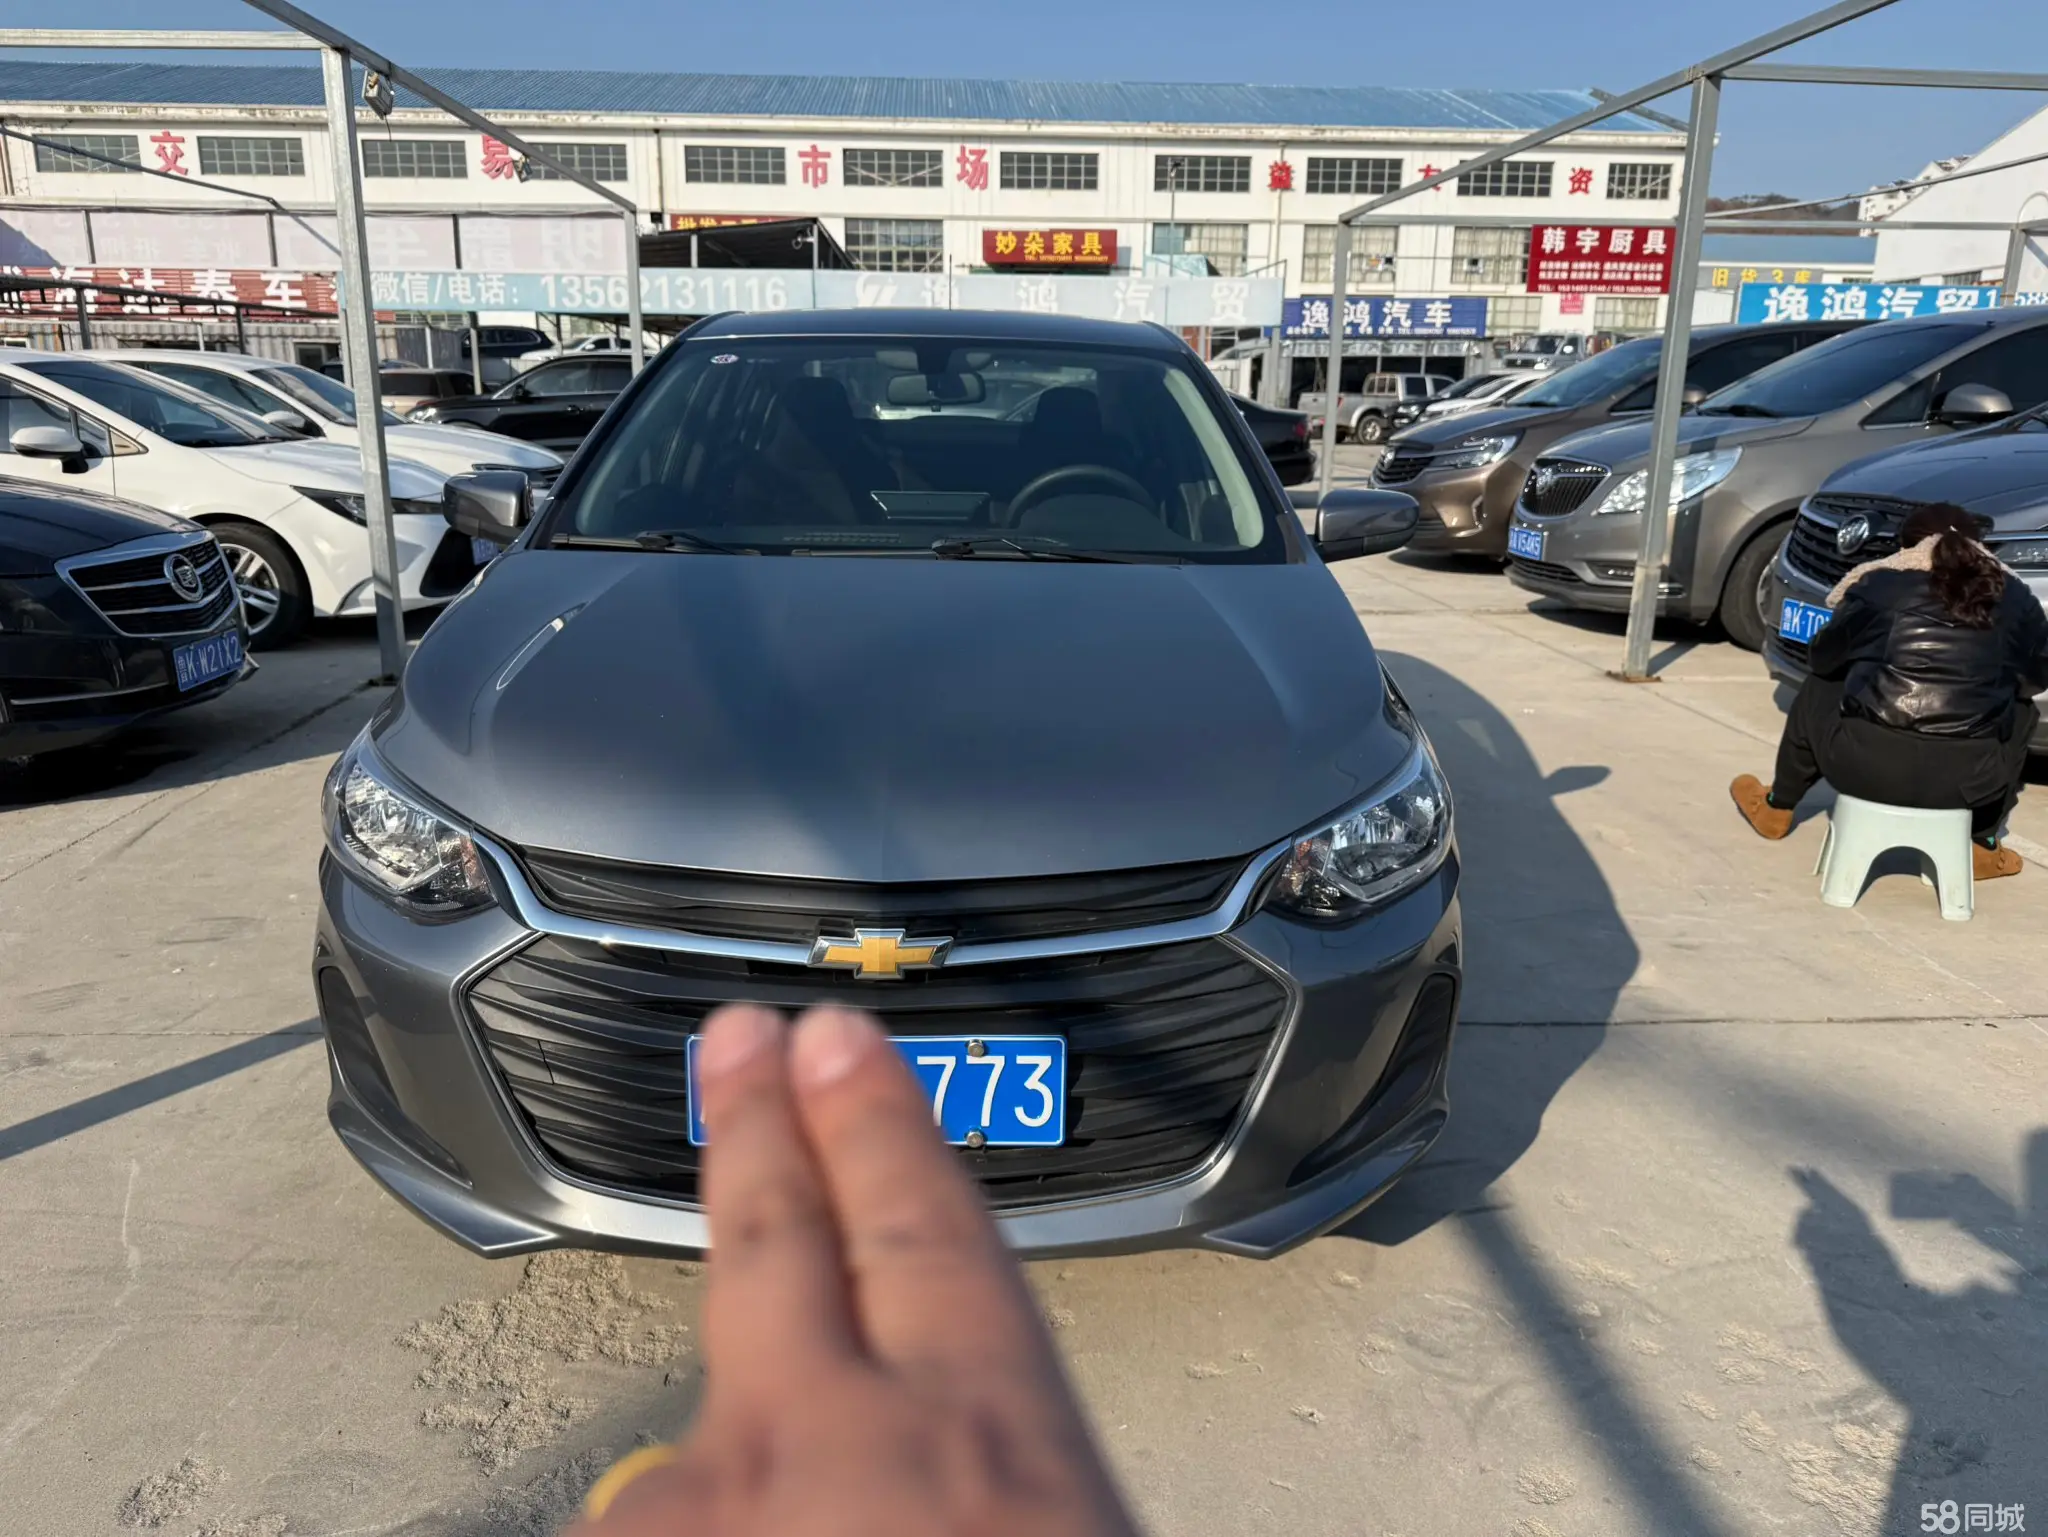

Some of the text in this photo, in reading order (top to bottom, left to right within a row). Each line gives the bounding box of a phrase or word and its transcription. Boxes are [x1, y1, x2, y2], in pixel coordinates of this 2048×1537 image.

[149, 128, 989, 191] 交 易 市 场
[1567, 166, 1594, 195] 资
[995, 231, 1102, 255] 妙朵家具
[1541, 227, 1667, 255] 韩宇厨具
[541, 273, 787, 311] 13562131116
[1302, 300, 1453, 328] 逸鸿汽车
[916, 1055, 1054, 1127] 773
